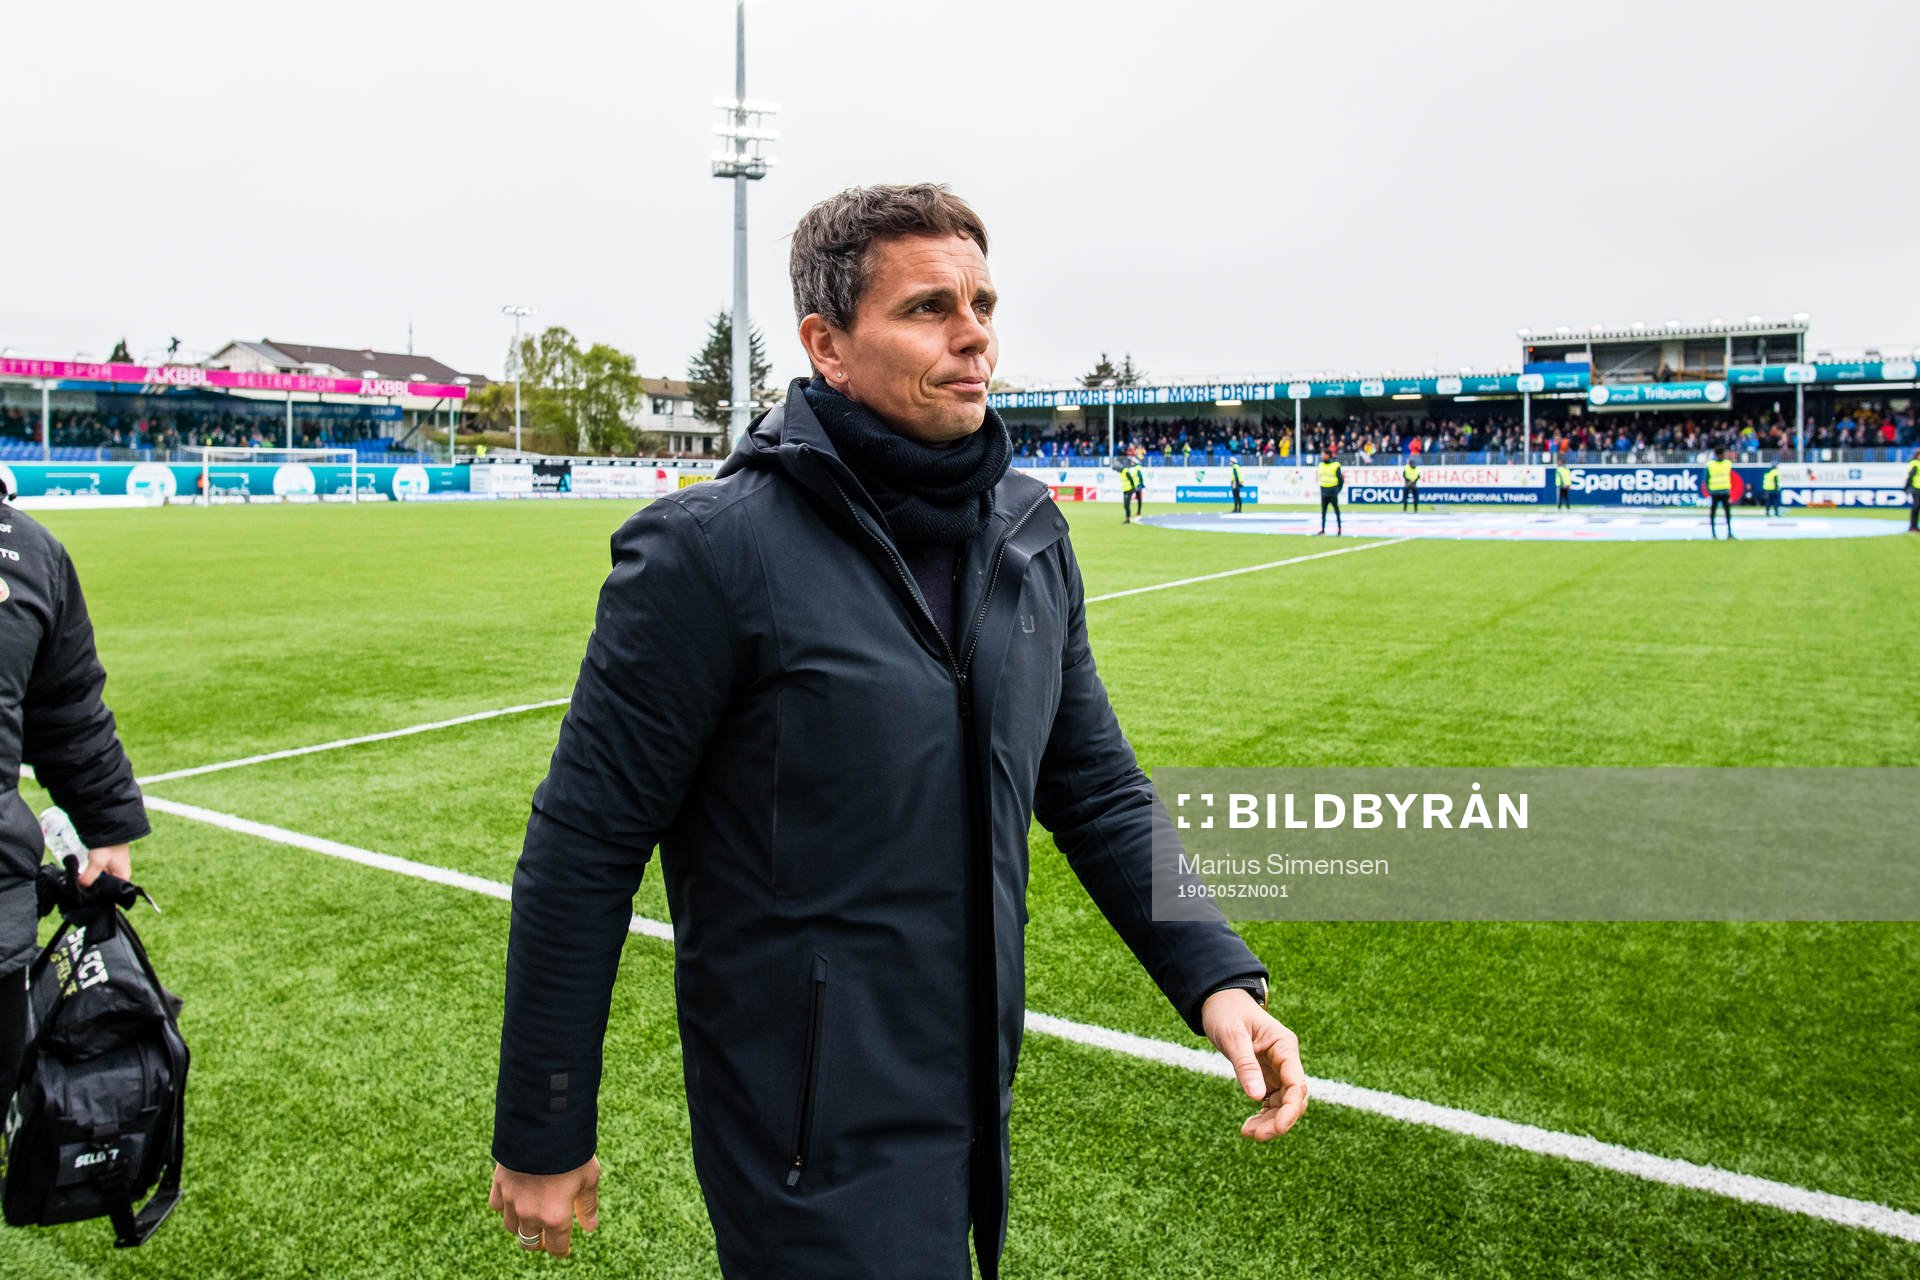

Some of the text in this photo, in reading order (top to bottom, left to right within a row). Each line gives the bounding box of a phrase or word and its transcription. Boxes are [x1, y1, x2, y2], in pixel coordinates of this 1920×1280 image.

[1017, 392, 1056, 407] DRIFT
[1067, 390, 1110, 405] MØRE
[1115, 388, 1159, 404] DRIFT
[1168, 386, 1216, 402] MØRE
[1222, 384, 1270, 400] DRIFT
[1644, 386, 1702, 400] Tribunen
[1570, 469, 1698, 494] SpareBank
[1621, 493, 1699, 505] NORDVEST
